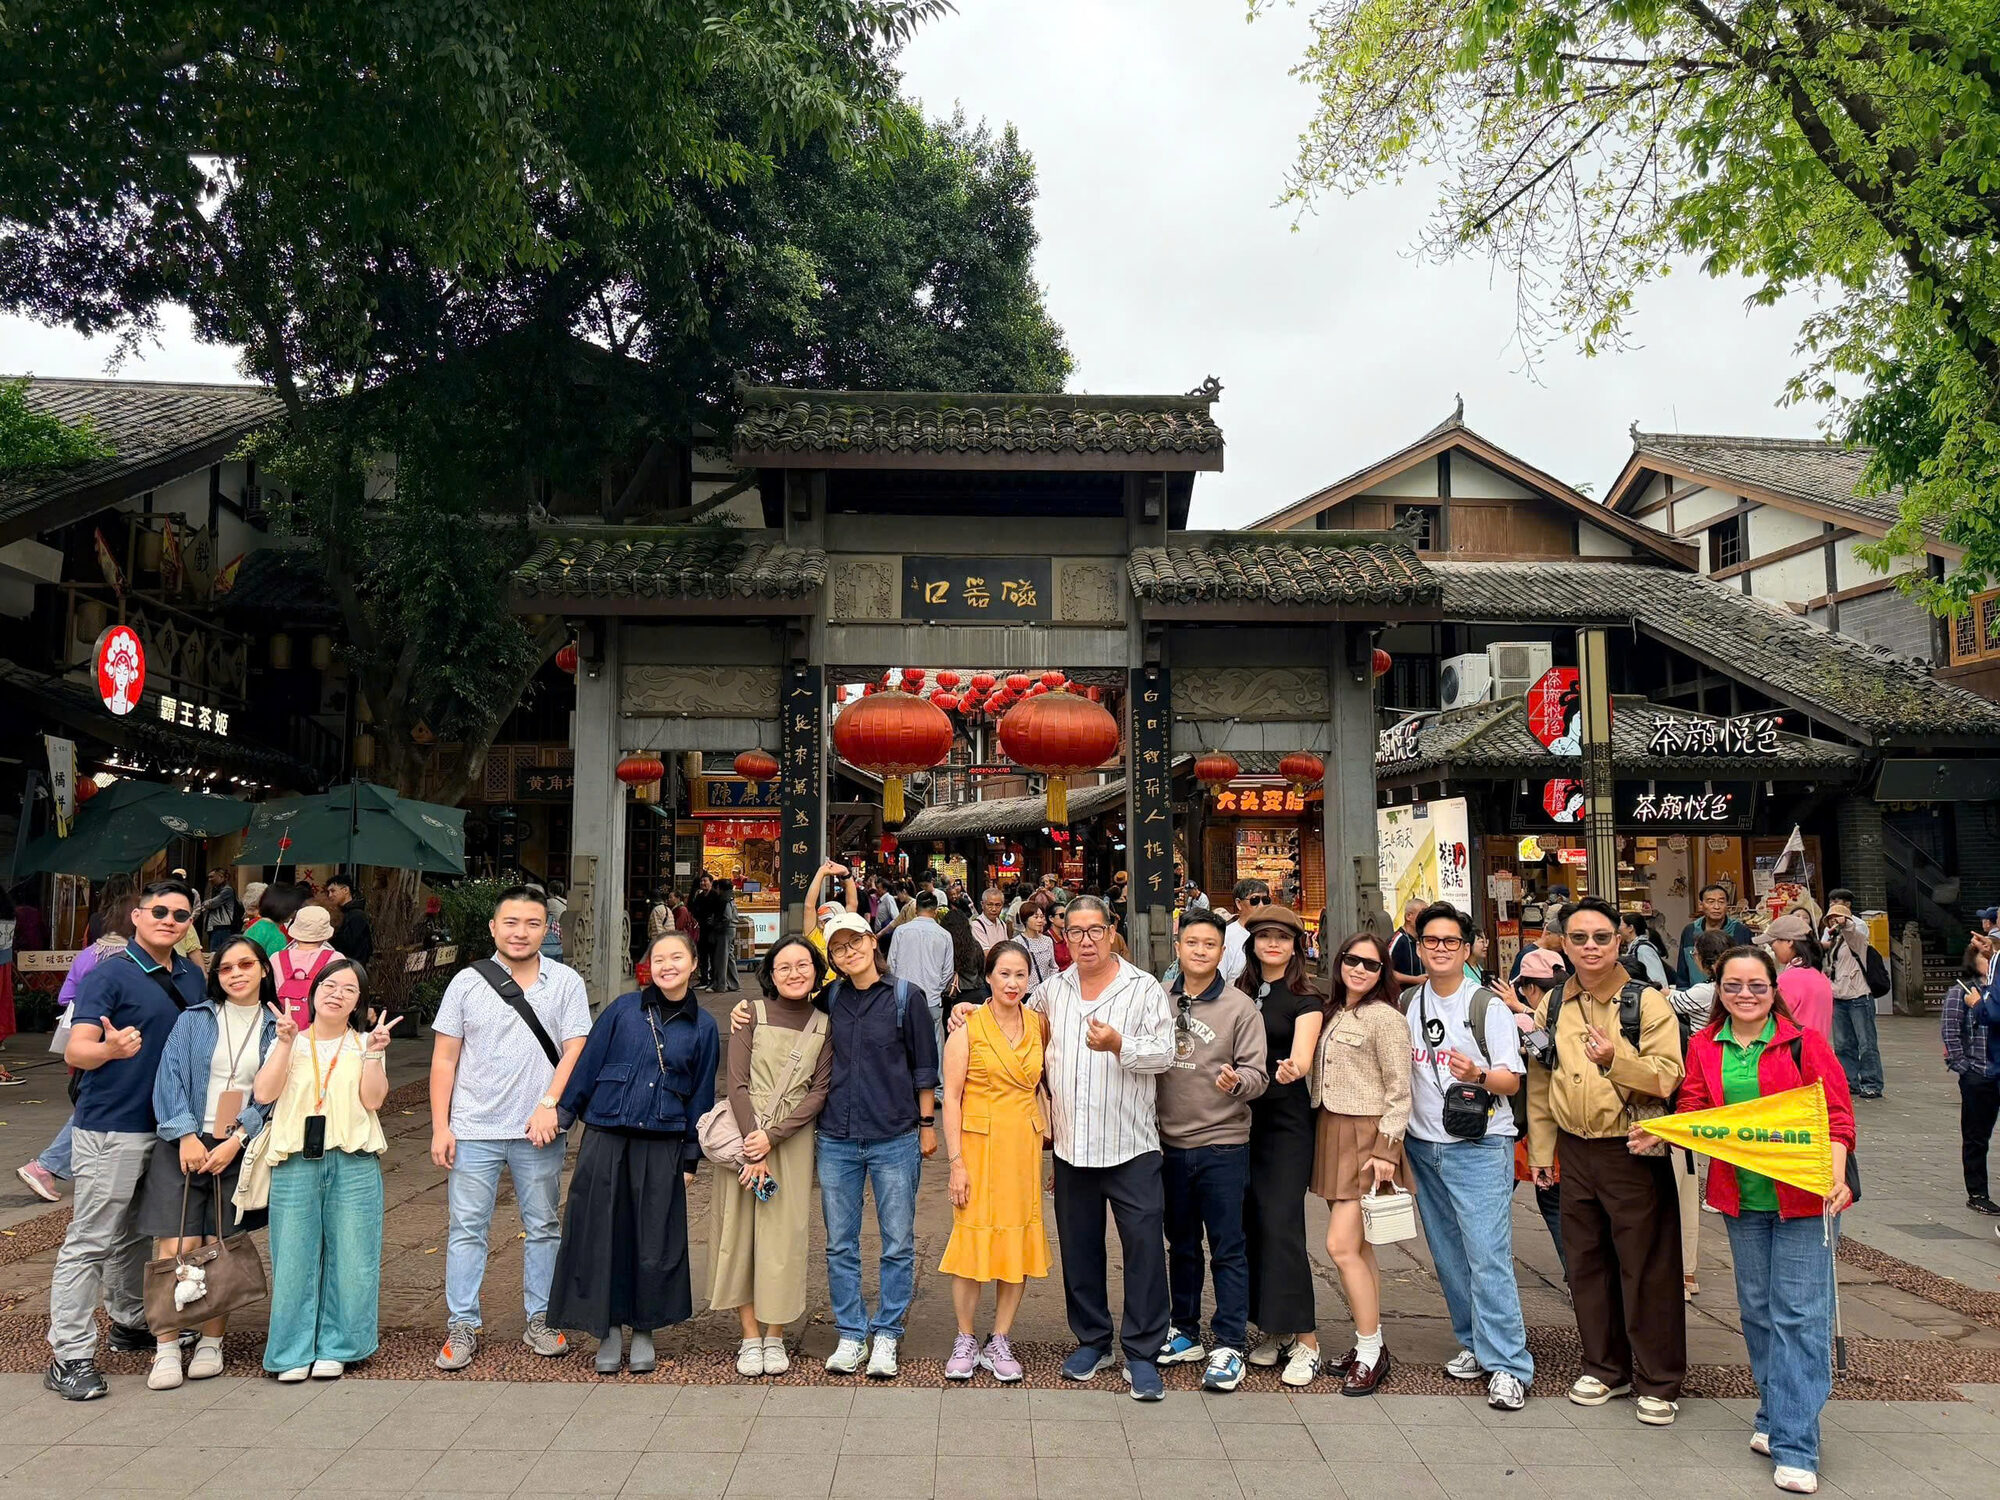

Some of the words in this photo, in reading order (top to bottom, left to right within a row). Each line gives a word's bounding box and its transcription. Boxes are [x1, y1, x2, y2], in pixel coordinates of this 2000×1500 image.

[160, 695, 229, 736] 霸王茶姬
[1689, 1124, 1730, 1139] TOP
